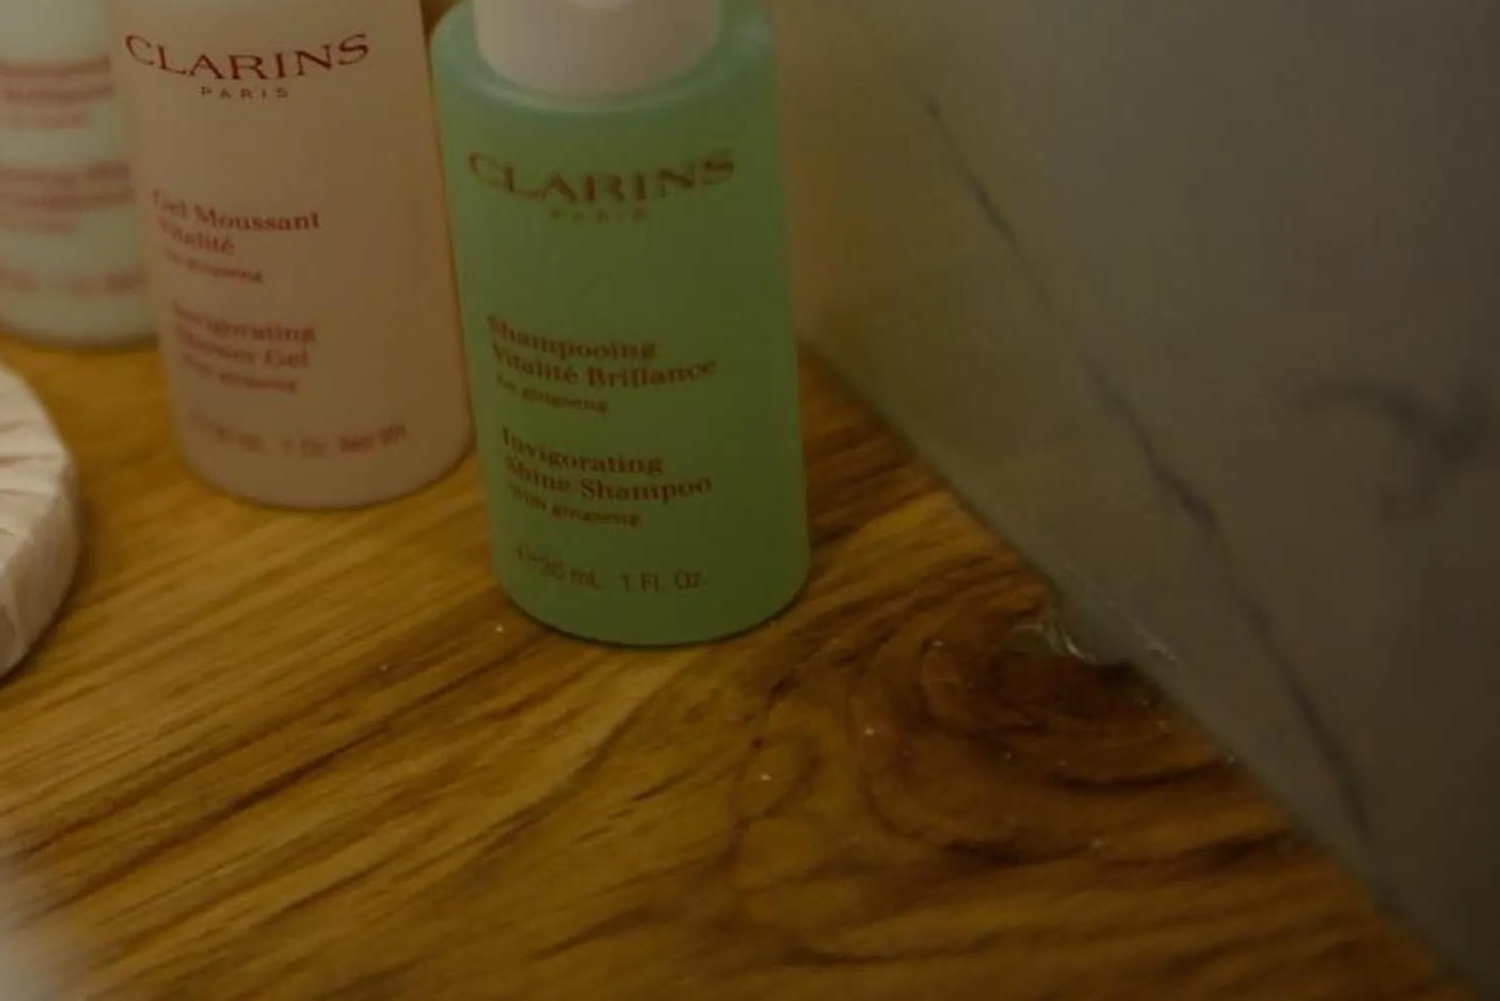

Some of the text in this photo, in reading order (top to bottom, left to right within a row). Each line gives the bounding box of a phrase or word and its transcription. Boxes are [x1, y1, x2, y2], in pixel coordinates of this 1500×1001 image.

[123, 30, 369, 81] CLARINS
[196, 84, 290, 101] PARIS
[468, 147, 736, 204] CLARINS
[193, 202, 321, 231] Moussant
[486, 314, 658, 361] Shampooing
[588, 359, 717, 389] Brillance
[501, 423, 664, 476] Invigorating
[579, 476, 713, 506] Shampoo
